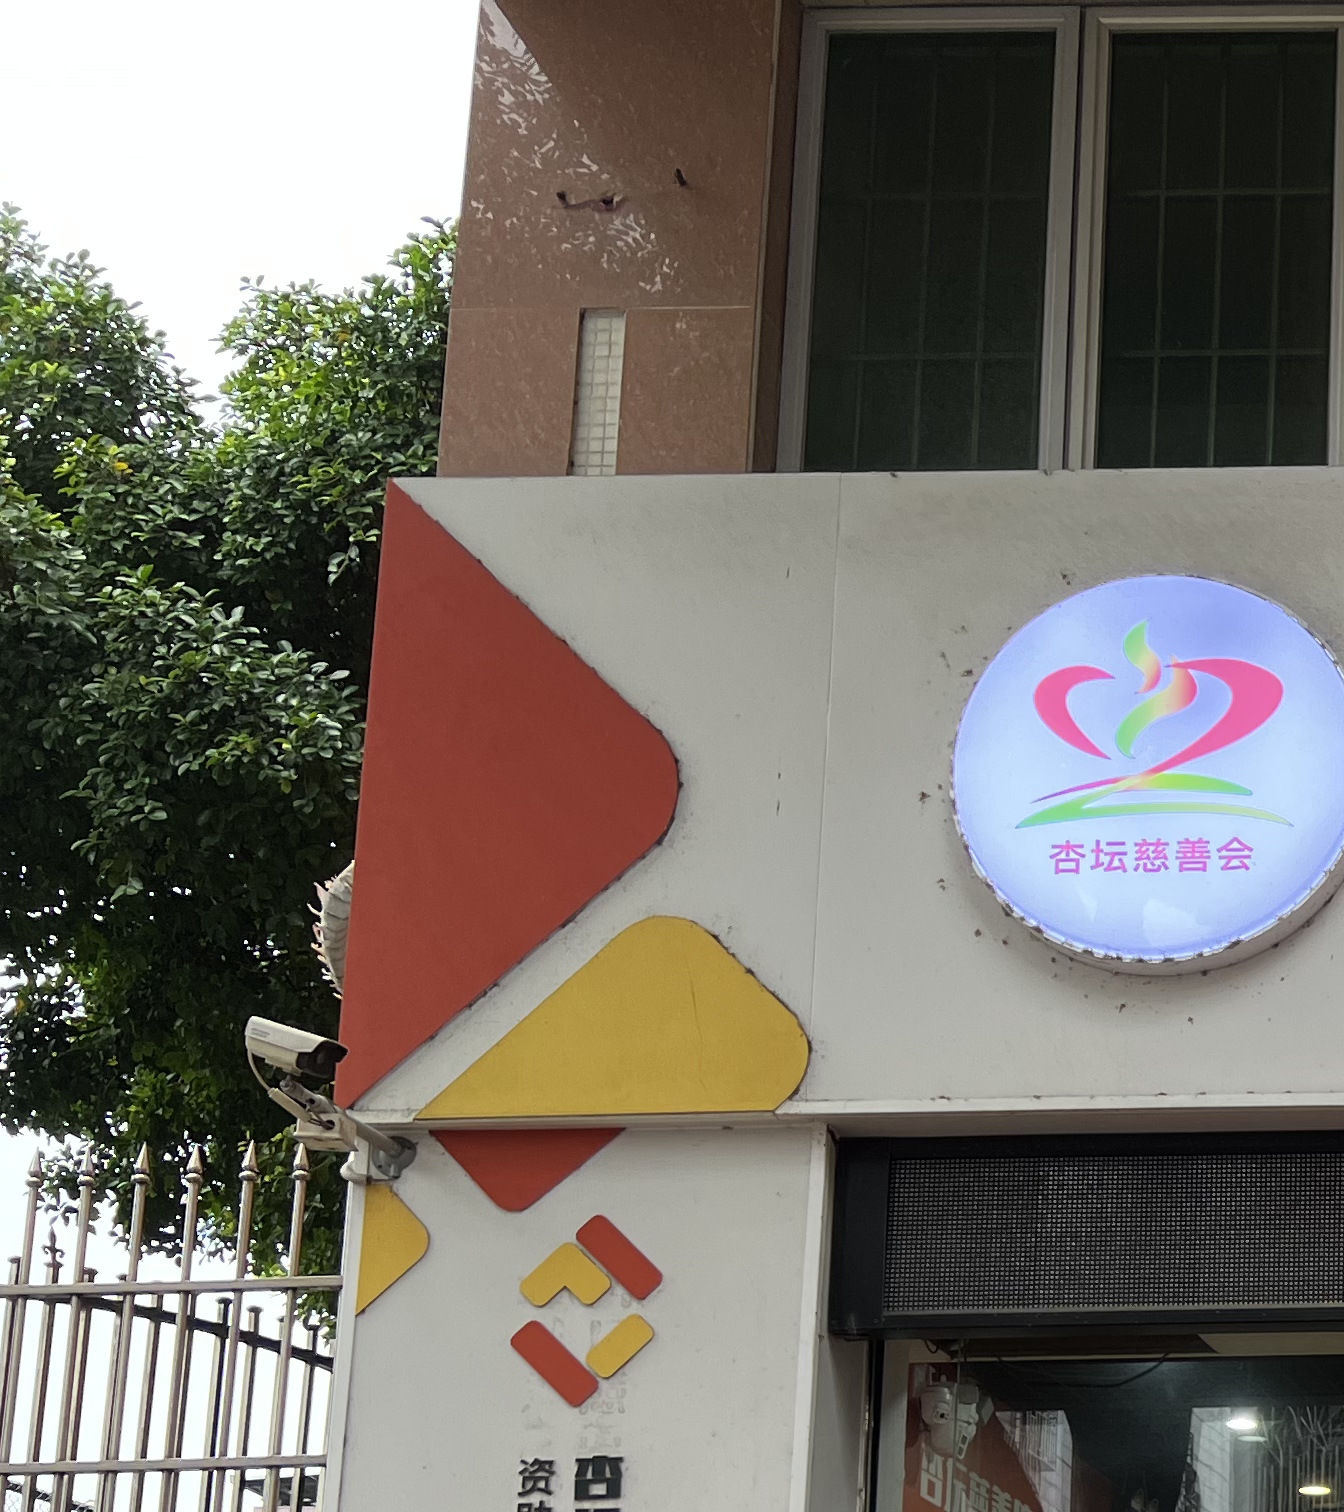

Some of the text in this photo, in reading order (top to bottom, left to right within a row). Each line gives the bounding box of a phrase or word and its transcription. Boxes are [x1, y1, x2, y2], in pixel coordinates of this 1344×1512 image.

[1049, 837, 1254, 874] 杏坛慈善会
